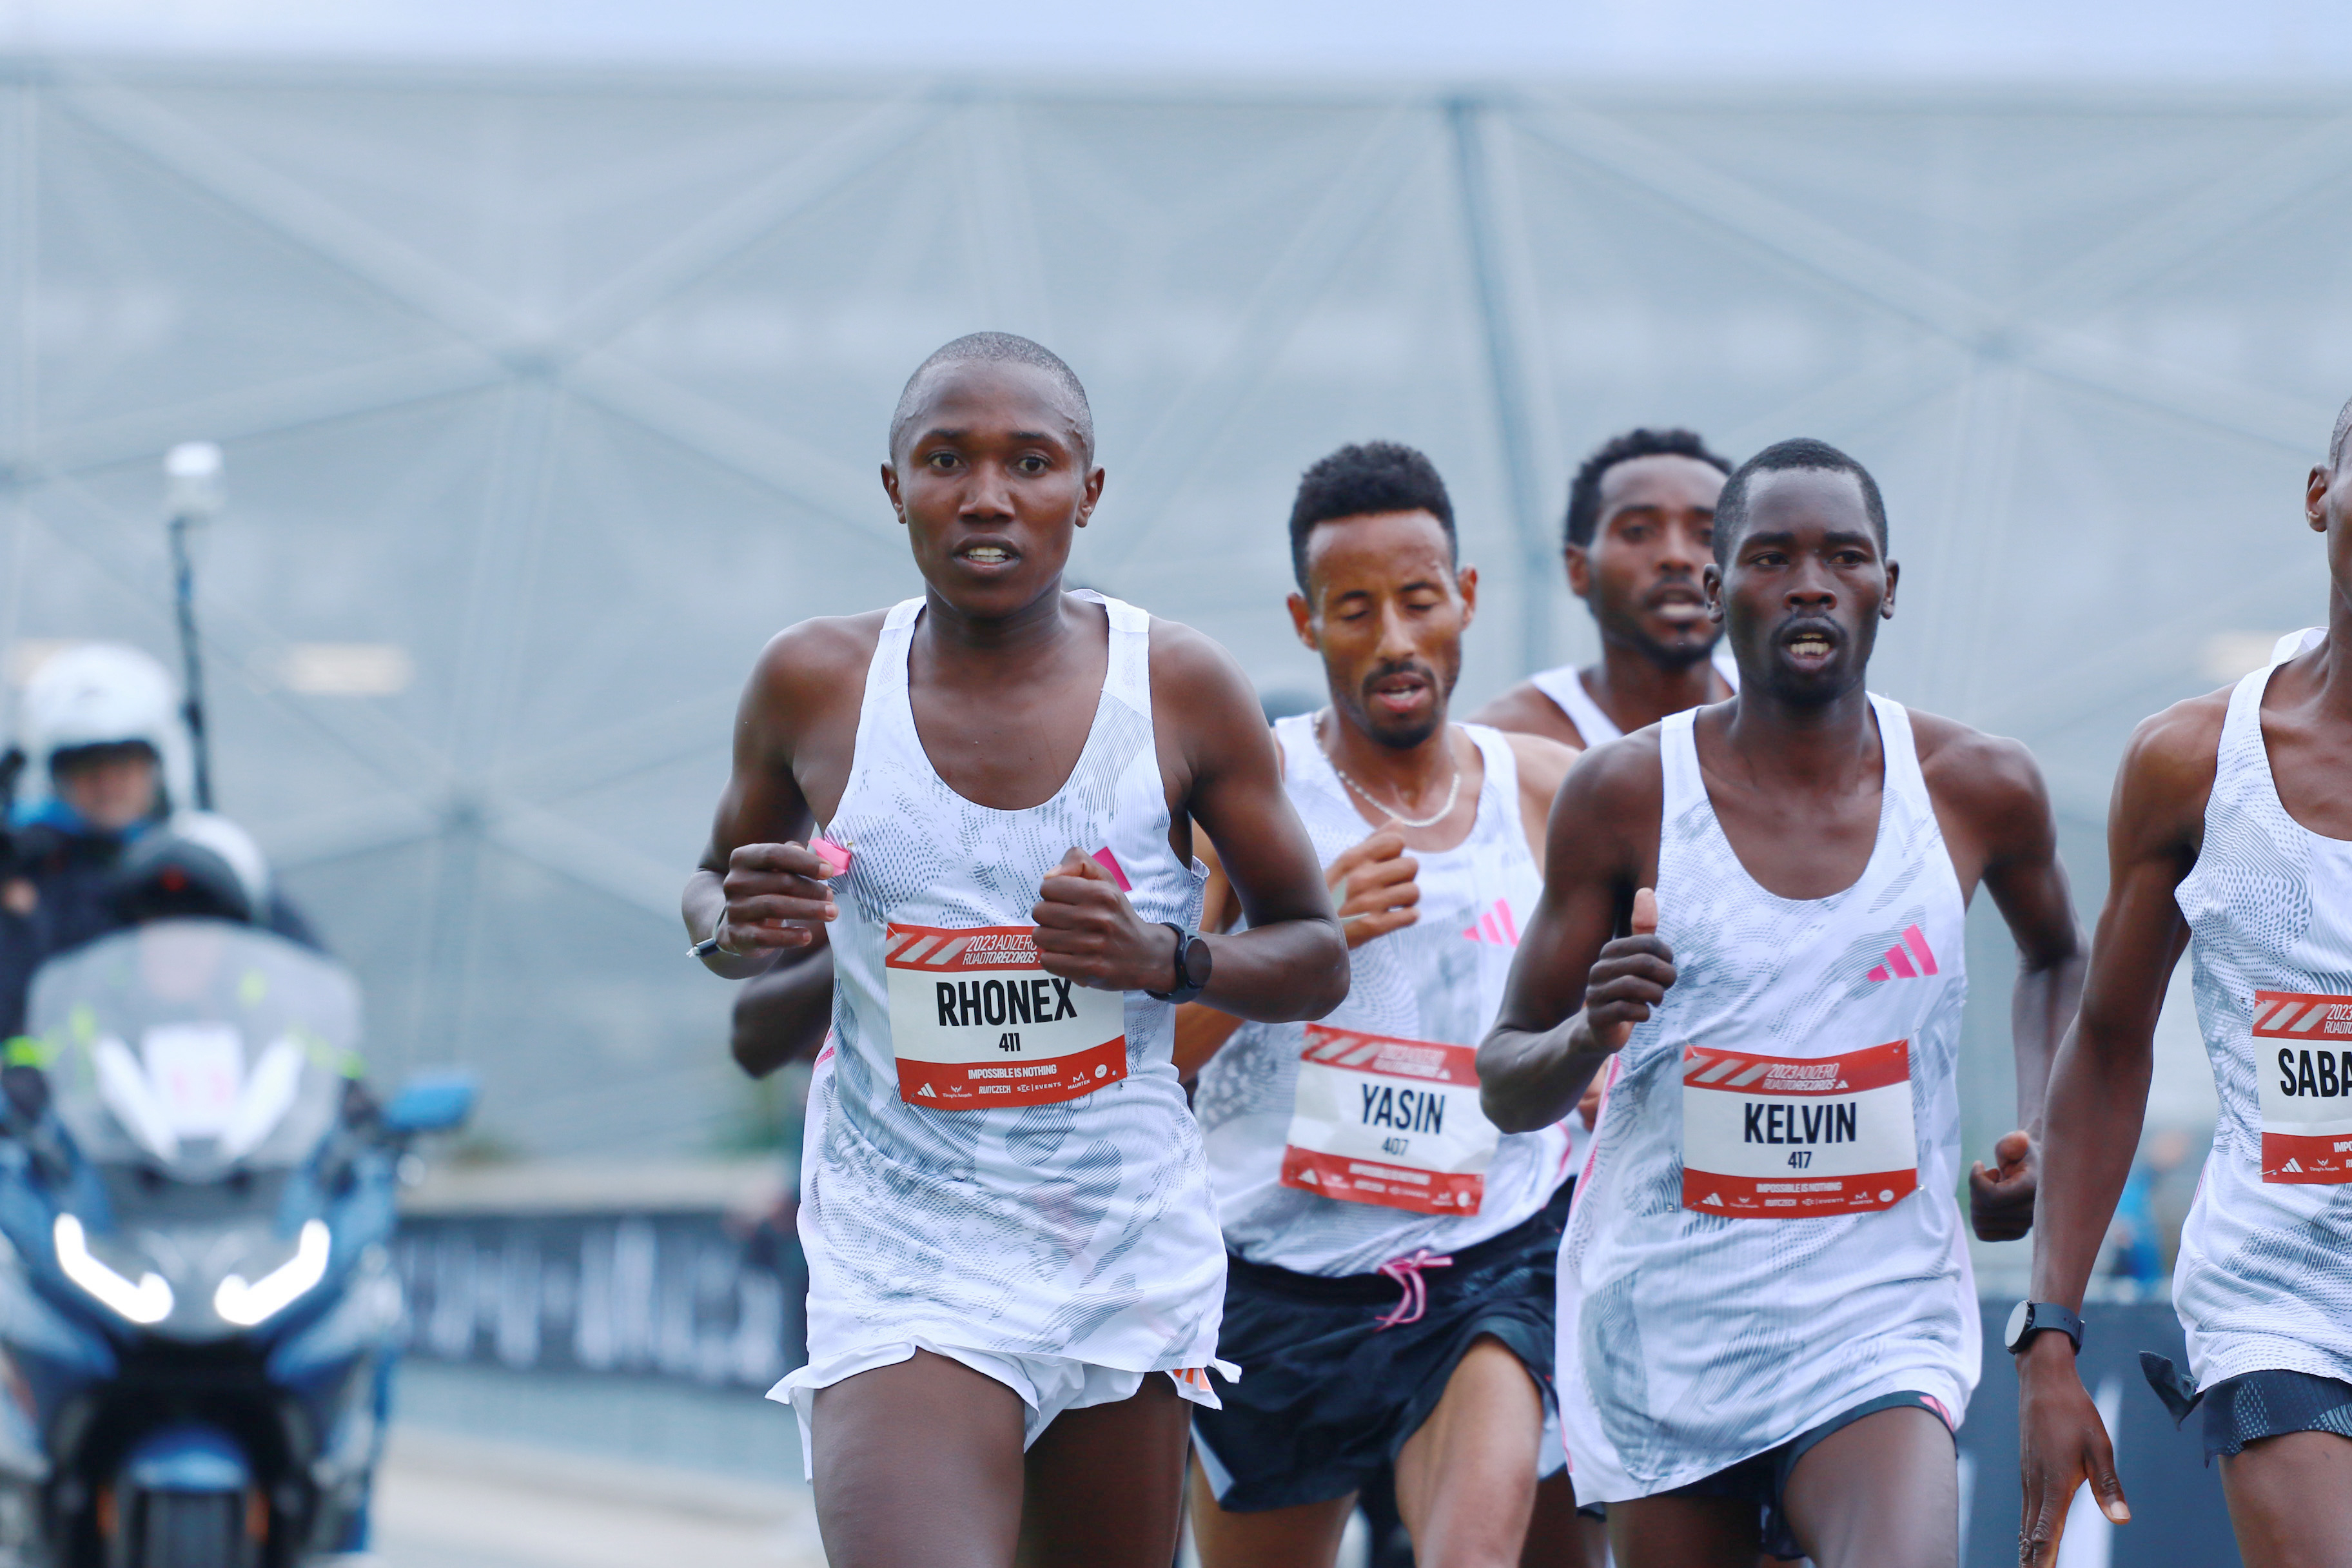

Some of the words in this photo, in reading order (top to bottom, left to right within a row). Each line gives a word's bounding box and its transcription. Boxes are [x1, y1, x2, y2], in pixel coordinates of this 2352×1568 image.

[936, 977, 1077, 1026] RHONEX
[999, 1032, 1021, 1052] 411
[968, 1068, 1014, 1080] IMPOSSIBLE
[1014, 1067, 1022, 1078] IS
[1023, 1064, 1057, 1077] NOTHING
[1068, 1079, 1090, 1090] MAURTEN
[1362, 1083, 1445, 1135] YASIN
[1745, 1102, 1856, 1144] KELVIN
[1382, 1137, 1409, 1156] 407
[1787, 1151, 1812, 1169] 417
[1756, 1183, 1800, 1193] IMPOSSIBLE
